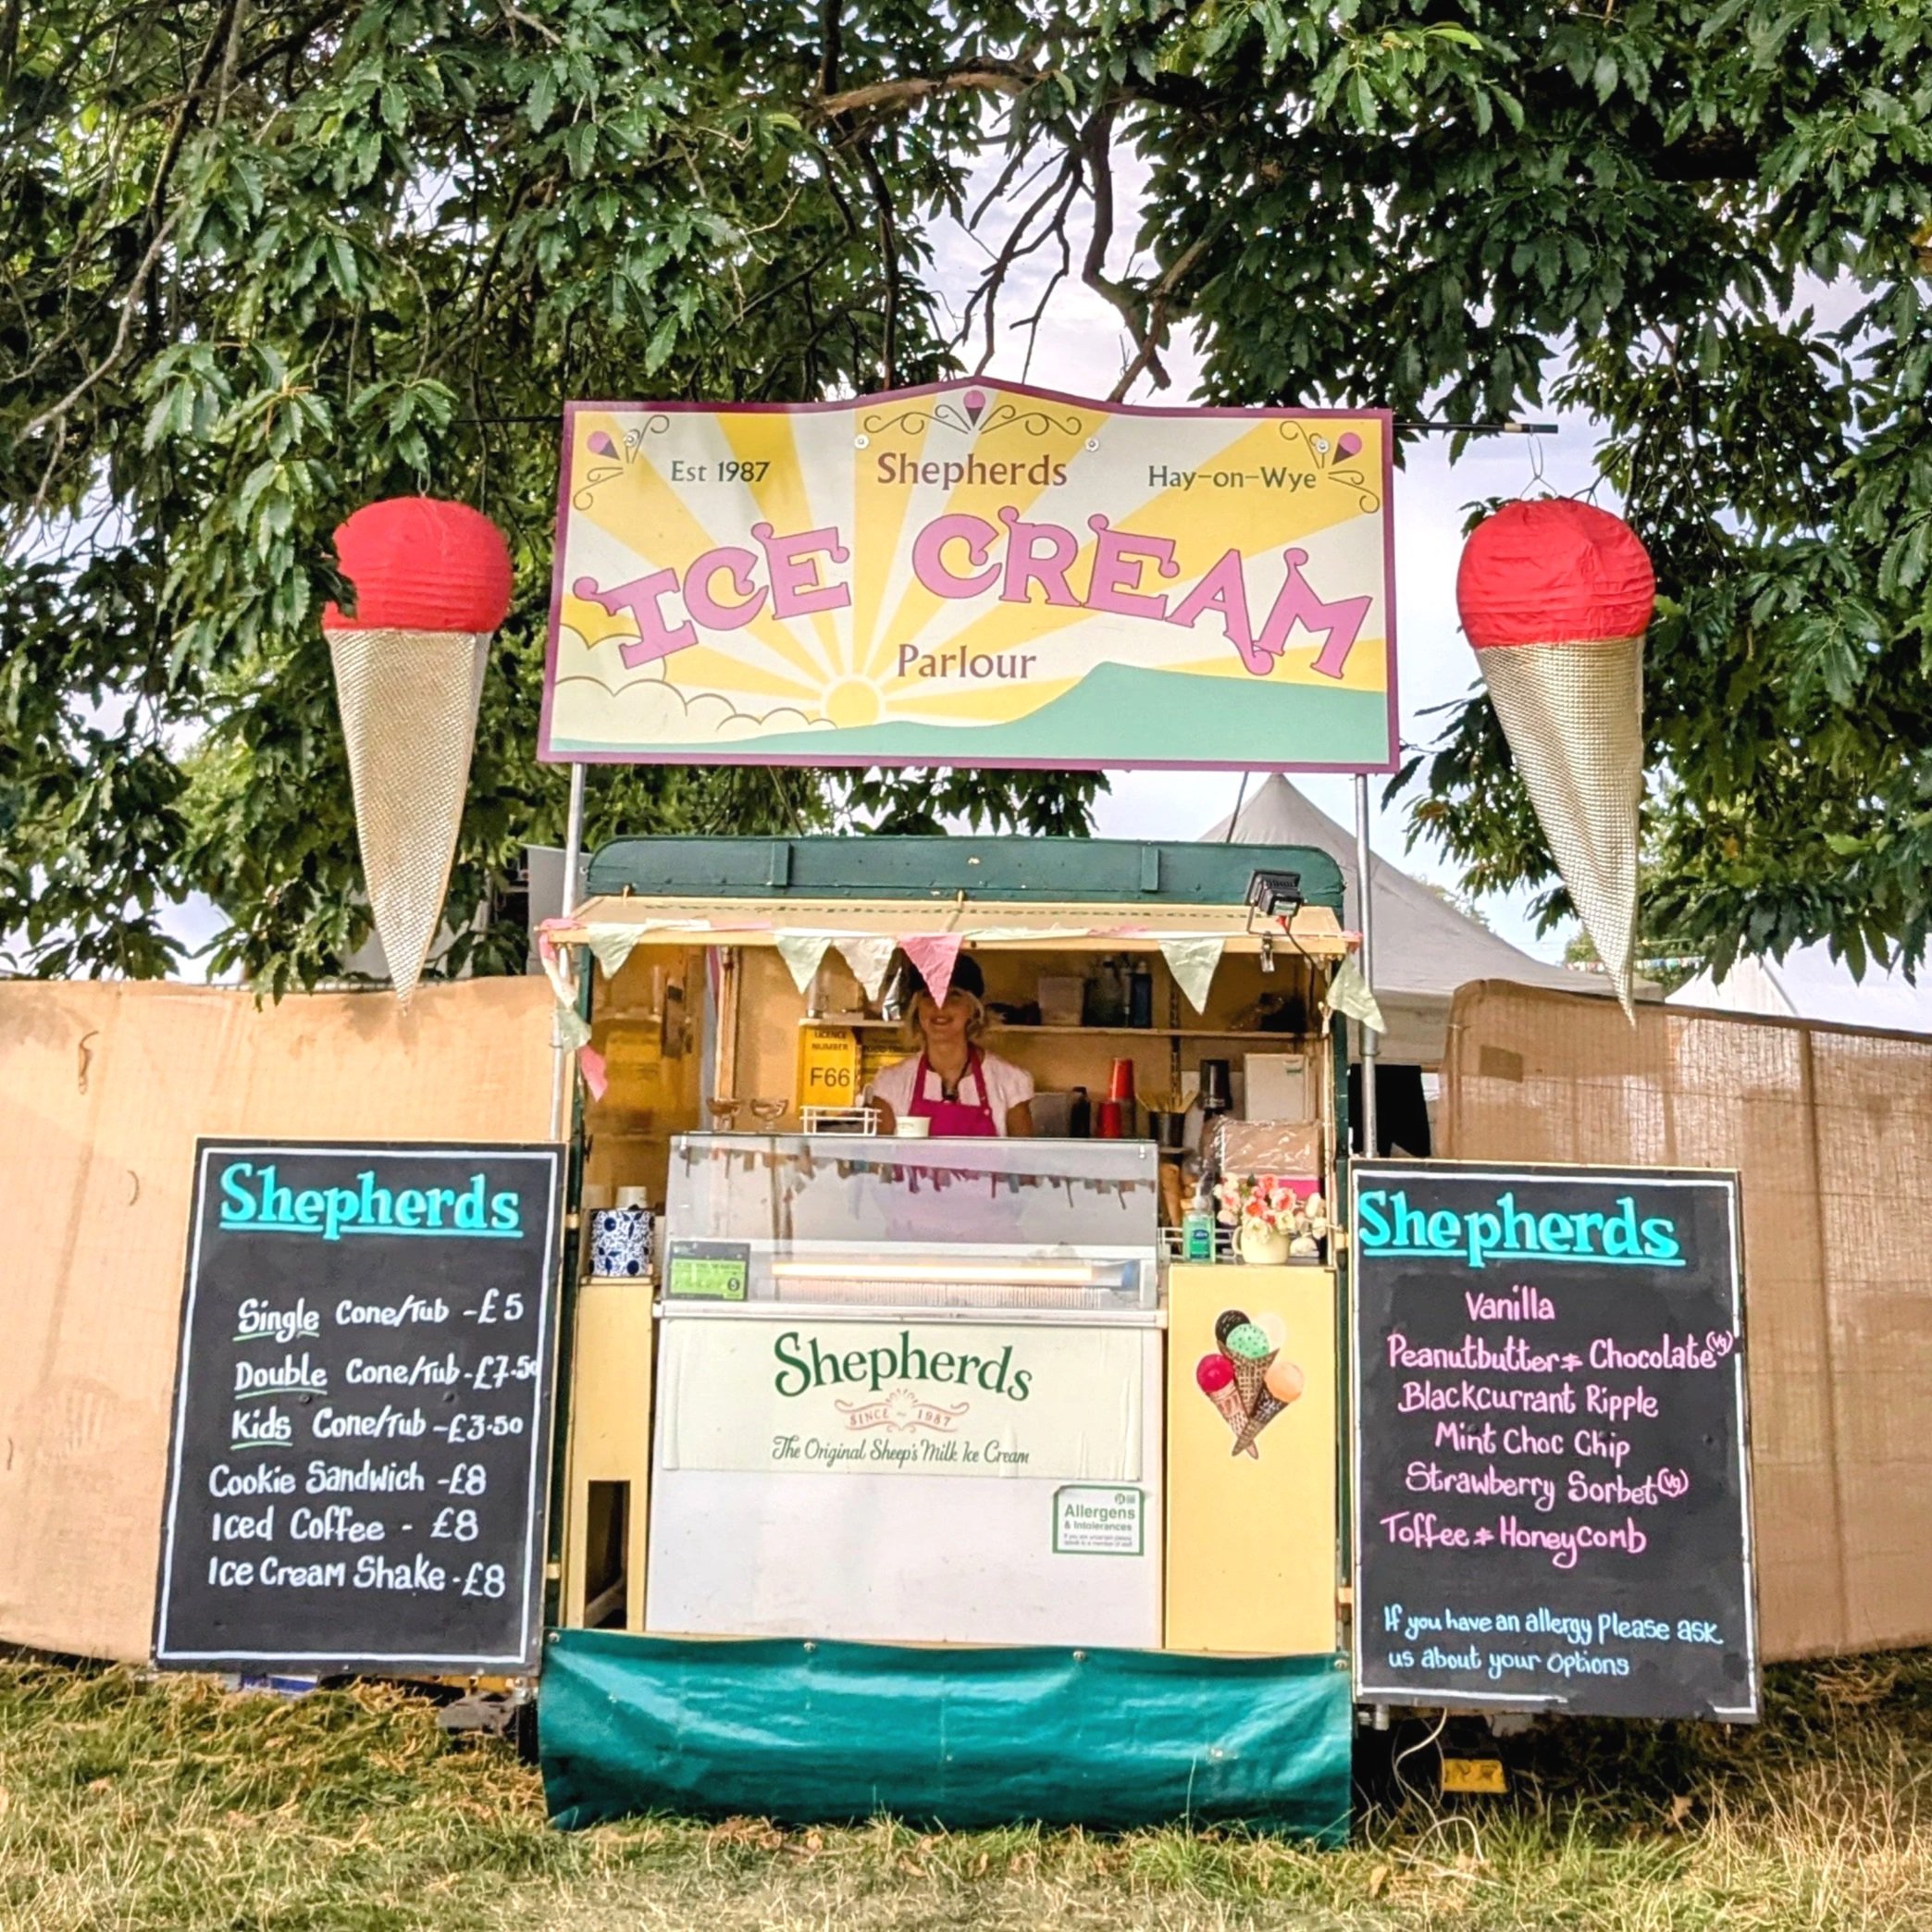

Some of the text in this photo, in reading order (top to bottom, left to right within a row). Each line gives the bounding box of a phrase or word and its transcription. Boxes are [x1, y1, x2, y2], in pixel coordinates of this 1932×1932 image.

[671, 460, 771, 482] Est 1987
[877, 452, 1067, 491] Shepherds
[1148, 465, 1317, 492] Hay-on-Wye
[573, 505, 1372, 679] ICE CREAM
[898, 644, 1036, 679] Parlour
[811, 1067, 850, 1087] F66
[220, 1162, 520, 1240] Shepherds
[1358, 1191, 1680, 1268] Shepherds
[239, 1299, 319, 1343] Single
[336, 1294, 449, 1327] Cone/Tub
[1465, 1284, 1555, 1321] Vanilla
[774, 1330, 1034, 1402] Shepherds
[1388, 1332, 1560, 1373] Peanutbutter
[1590, 1333, 1716, 1369] Chocolate
[235, 1354, 328, 1389] Double
[346, 1354, 460, 1385] Cone/Tub
[849, 1409, 952, 1427] SINCE 1987
[1398, 1381, 1659, 1421] Blackcurrant Ripple
[232, 1411, 291, 1442] Kids
[313, 1406, 427, 1439] Cone/Tub
[772, 1434, 1030, 1469] The Original Sheep's Milk Ice Cream
[1435, 1422, 1631, 1468] Mint Choc Chip
[209, 1464, 296, 1498] Cookie
[306, 1460, 425, 1494] Sandwich
[1406, 1461, 1555, 1511] Strawberry
[1567, 1469, 1658, 1505] Sorbet
[212, 1506, 274, 1542] Iced
[291, 1507, 385, 1542] Coffee
[430, 1507, 479, 1542] £8
[1064, 1504, 1135, 1522] Allergens
[1064, 1520, 1133, 1531] & Intolerances
[1380, 1511, 1469, 1548] Toffee
[1500, 1516, 1647, 1567] Honeycomb
[209, 1557, 254, 1587] Ice
[260, 1557, 345, 1588] Cream
[353, 1554, 446, 1591] Shake
[1384, 1605, 1724, 1645] If you have an allergy Please ask
[1389, 1652, 1414, 1668] us
[1421, 1647, 1482, 1671] about
[1488, 1653, 1542, 1678] your
